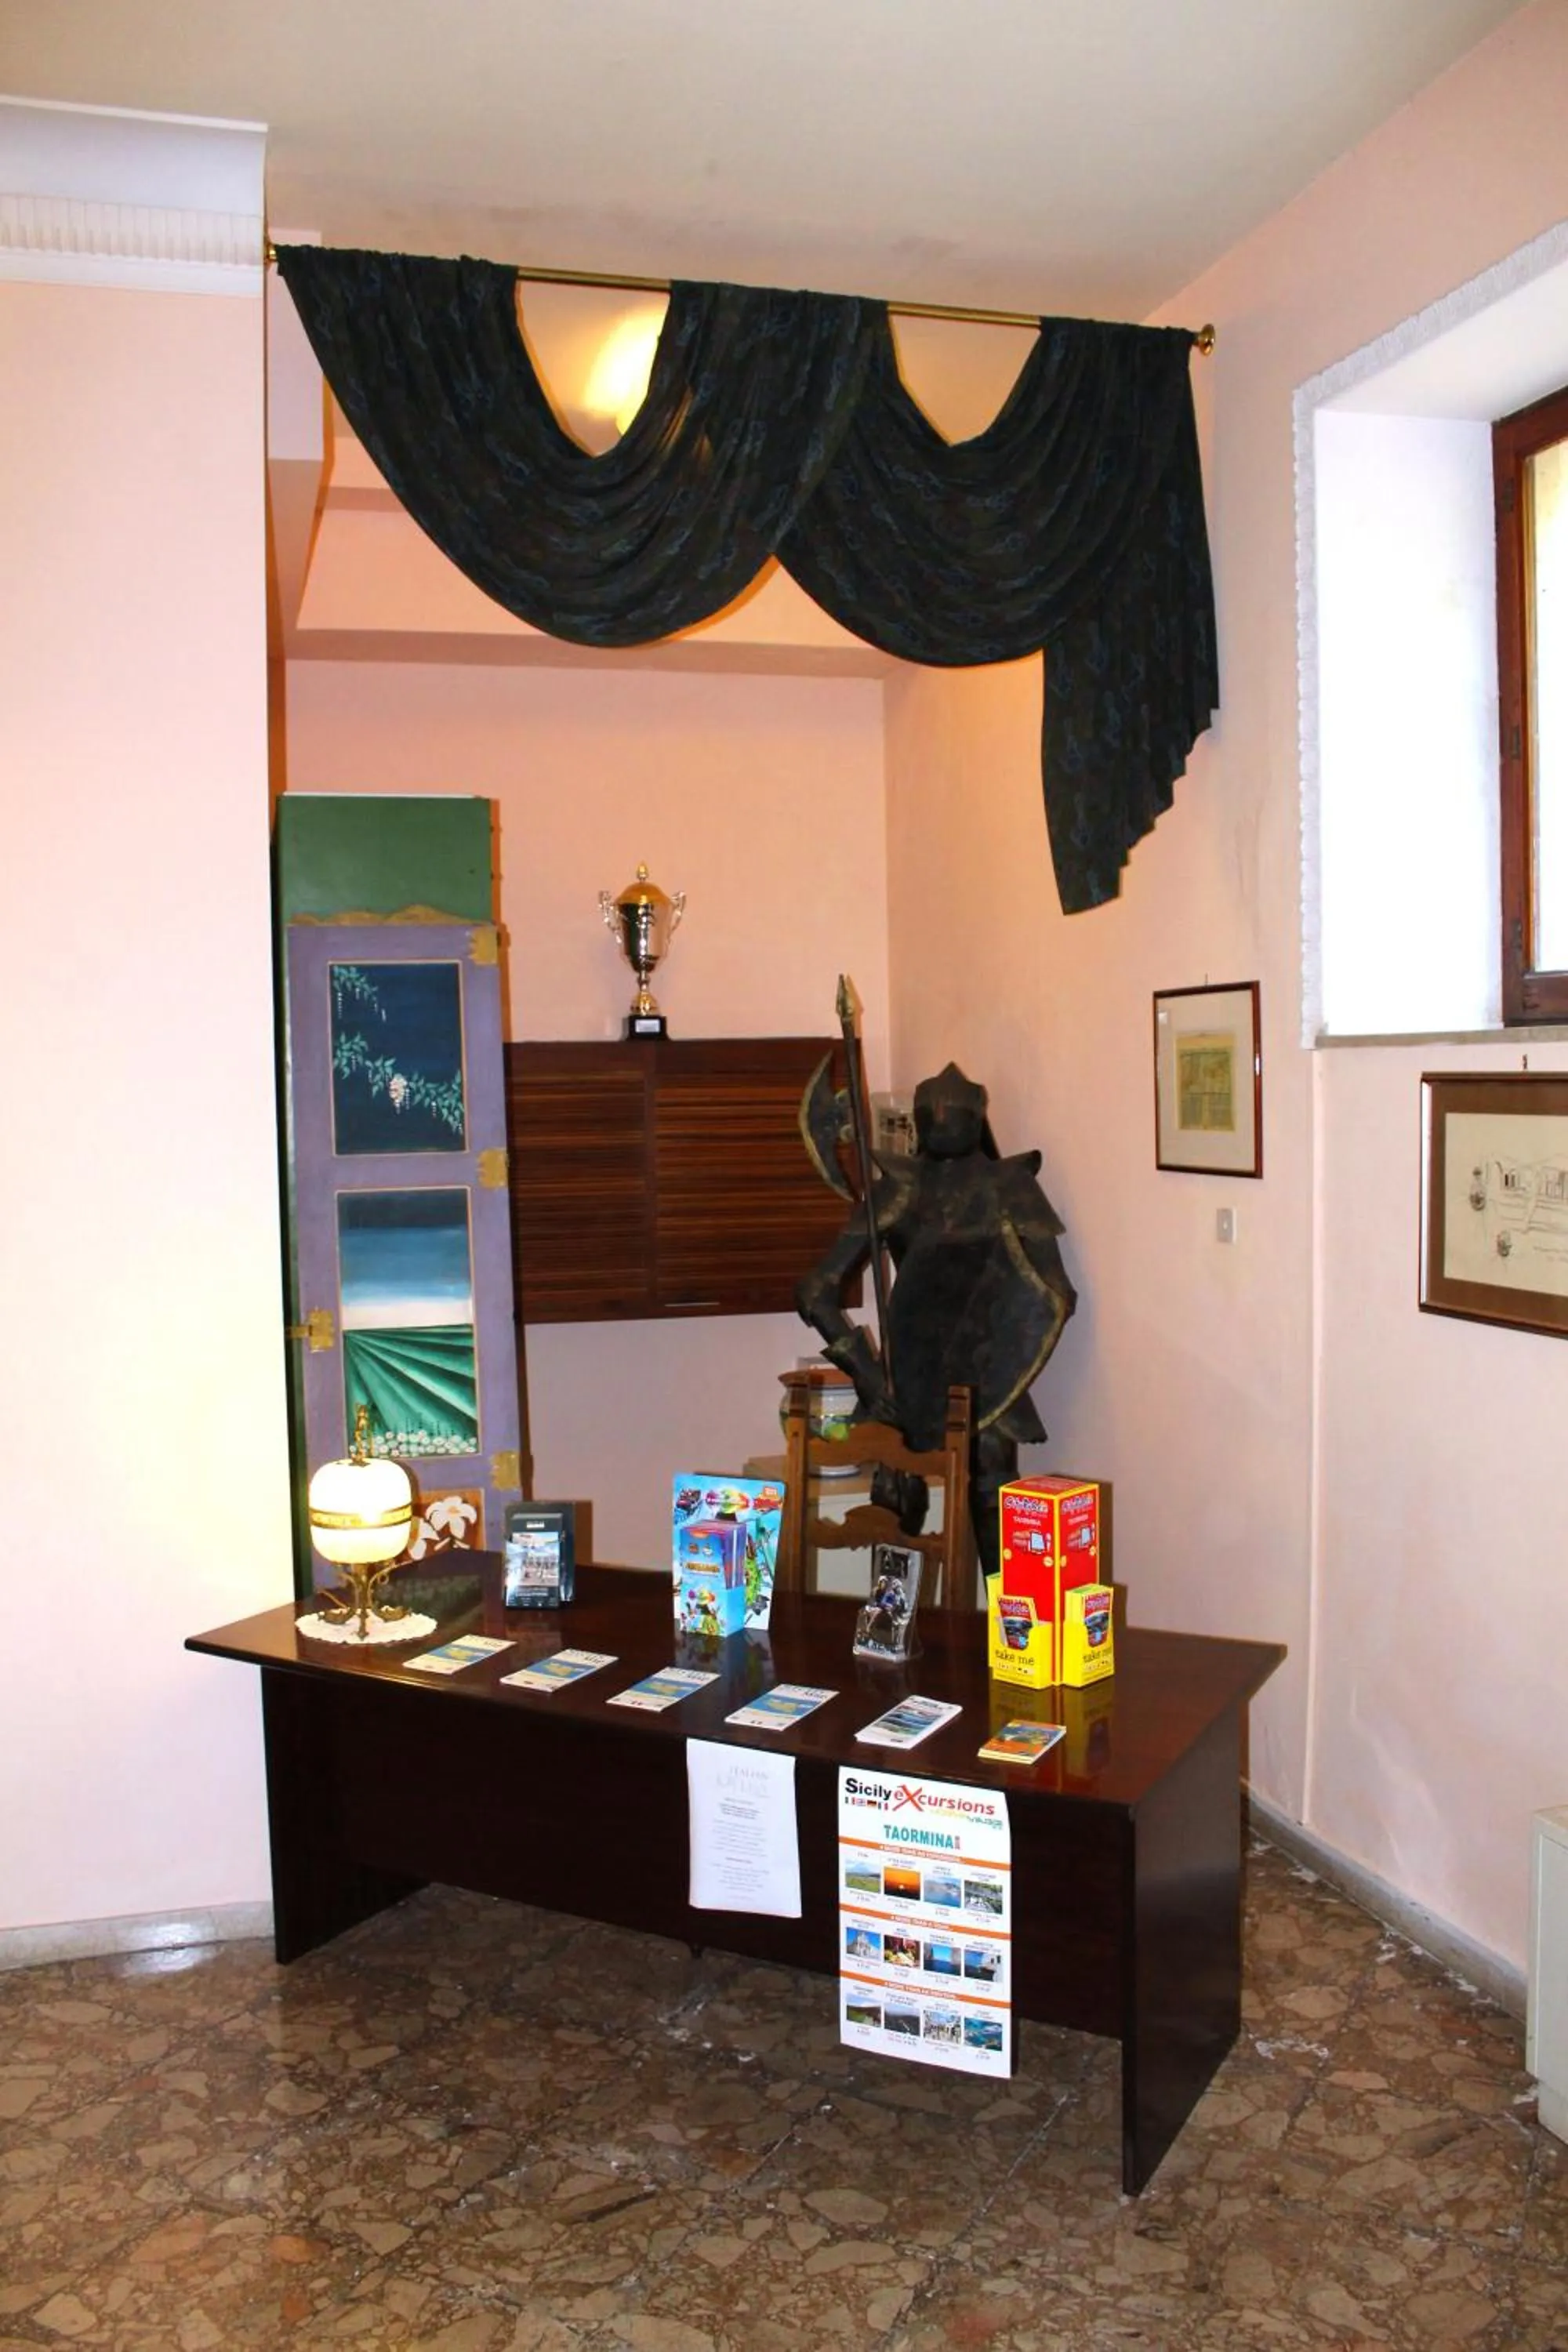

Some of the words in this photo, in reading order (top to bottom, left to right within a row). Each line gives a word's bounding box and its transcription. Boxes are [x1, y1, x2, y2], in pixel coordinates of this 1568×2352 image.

[995, 1649, 1015, 1662] take
[1018, 1655, 1035, 1666] me
[845, 1777, 892, 1801] Sicily
[884, 1824, 954, 1849] TAORMINA
